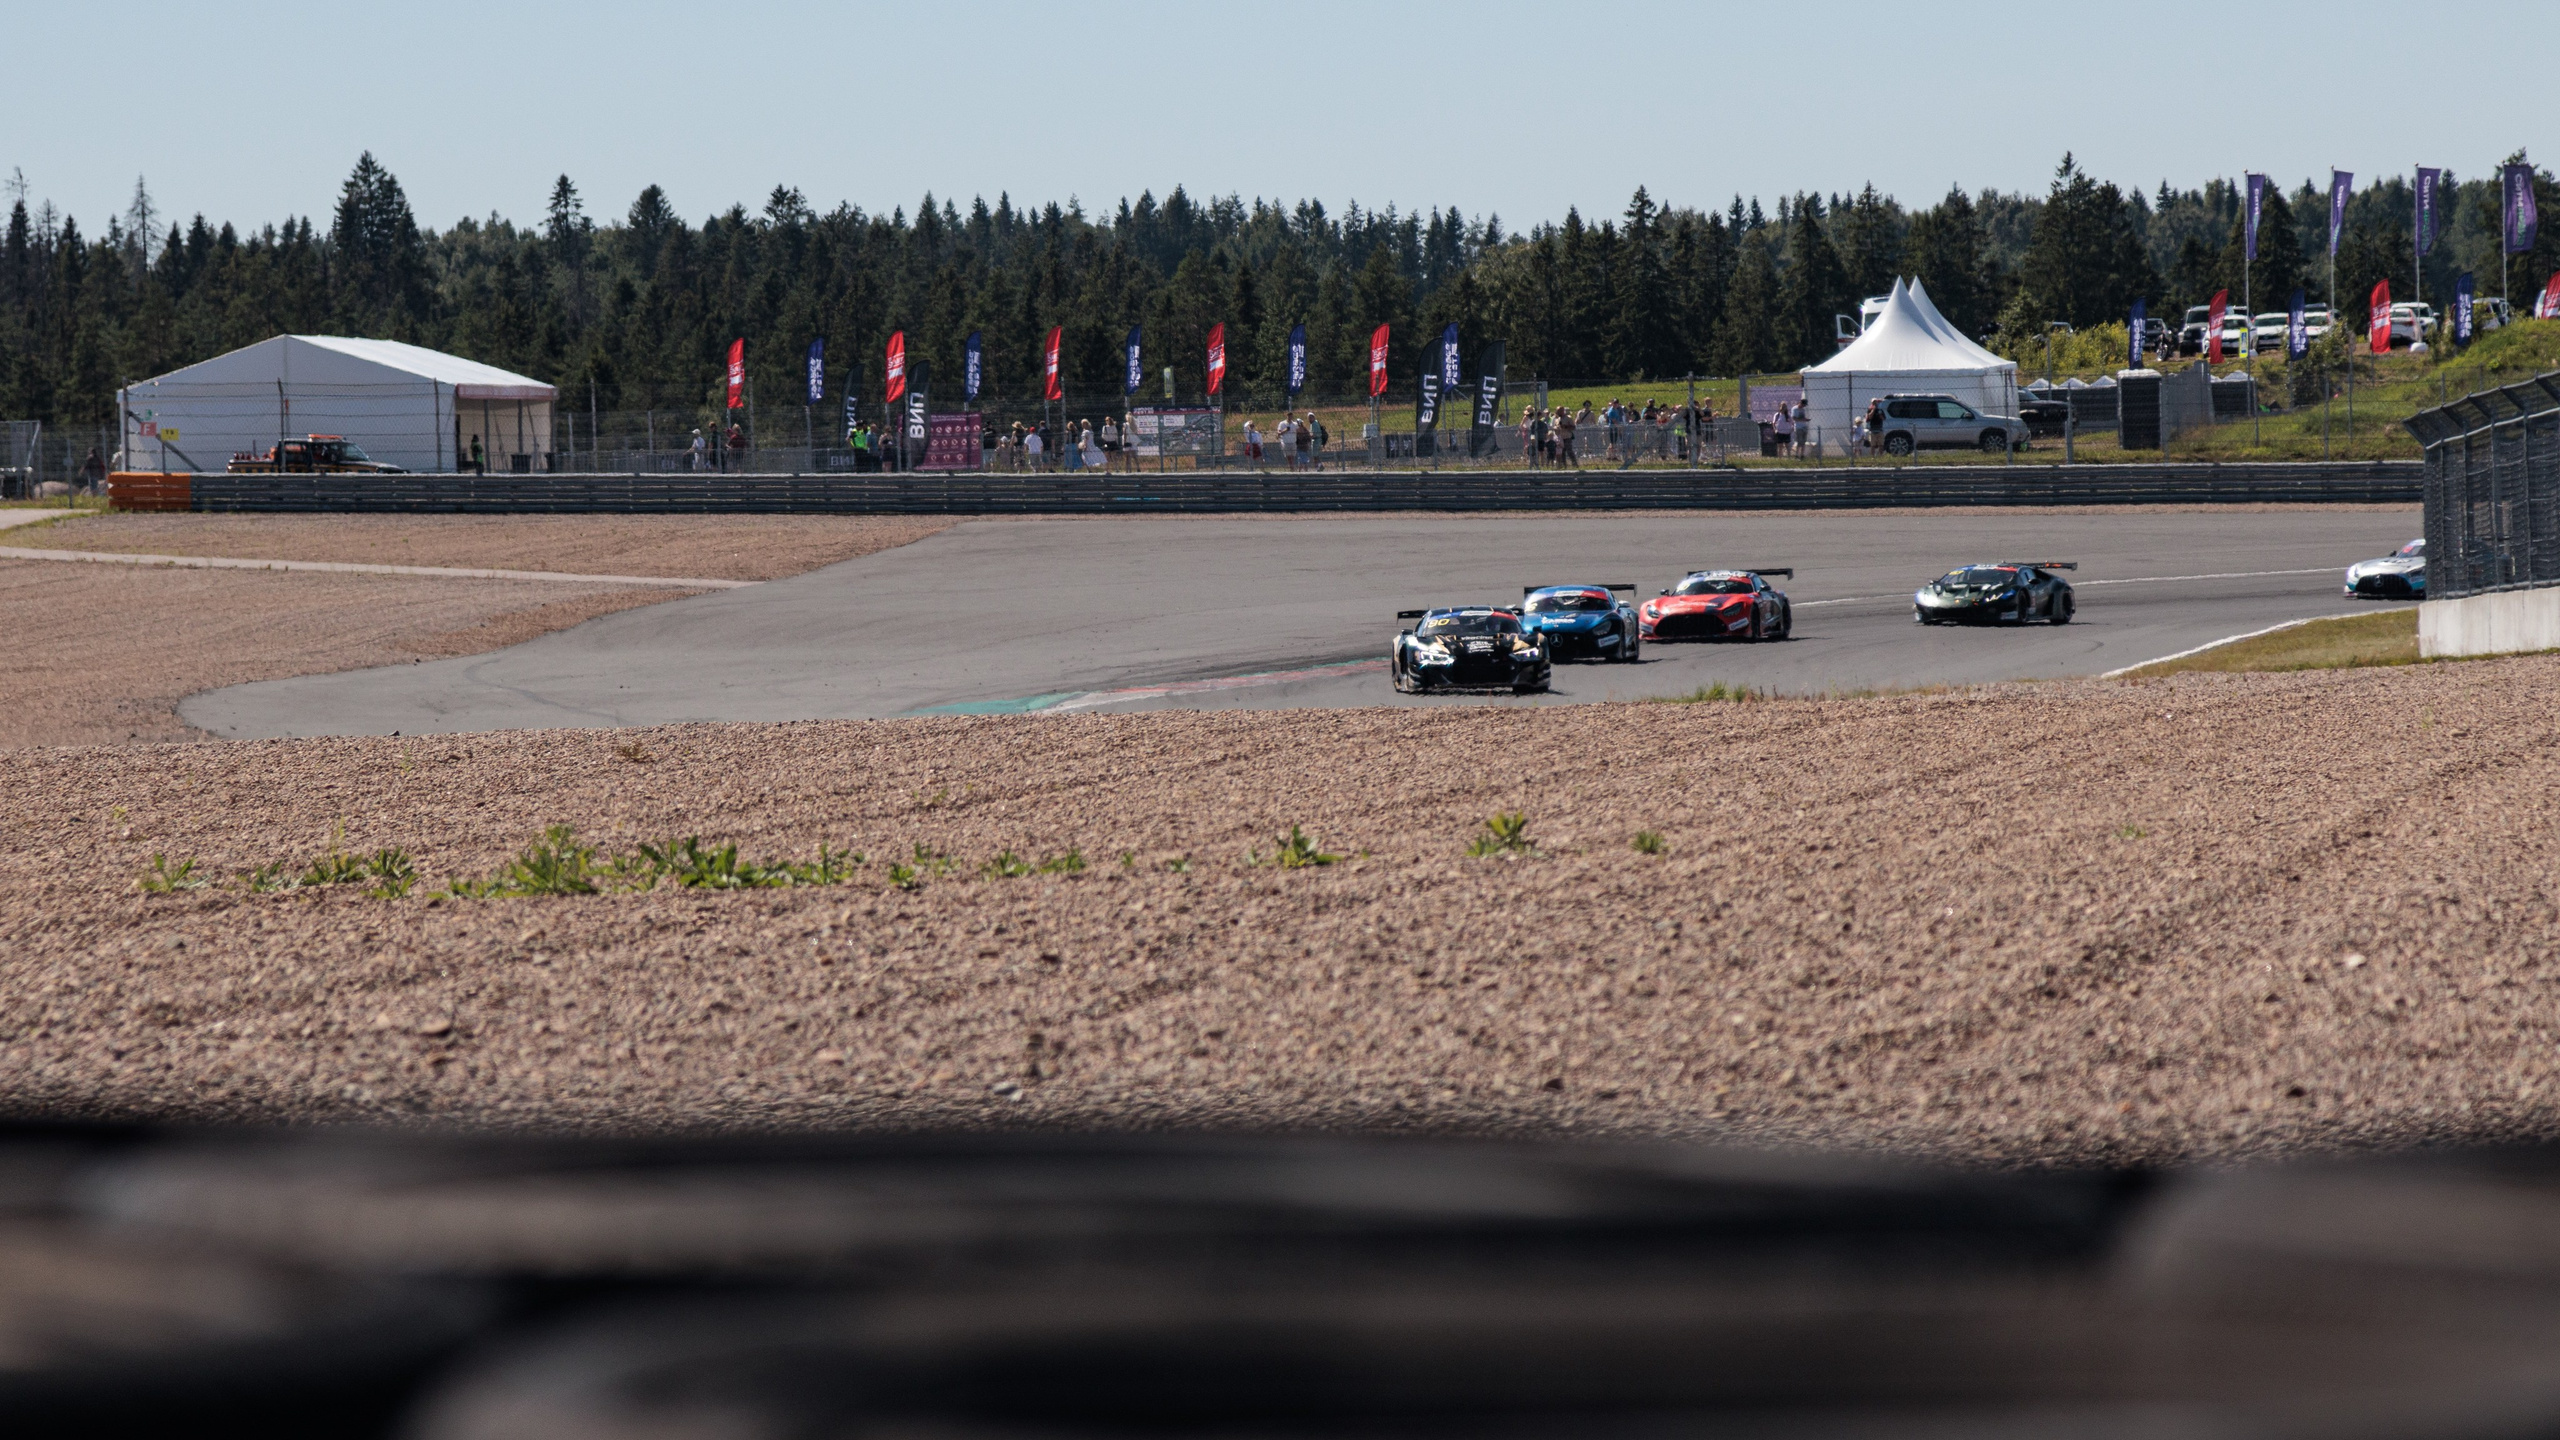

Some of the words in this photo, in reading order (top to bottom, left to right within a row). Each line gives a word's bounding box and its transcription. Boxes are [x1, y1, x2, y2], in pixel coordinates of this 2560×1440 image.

[909, 391, 925, 439] ВИП
[1421, 374, 1437, 423] ВИП
[1478, 376, 1497, 426] ВИП
[144, 423, 151, 435] F
